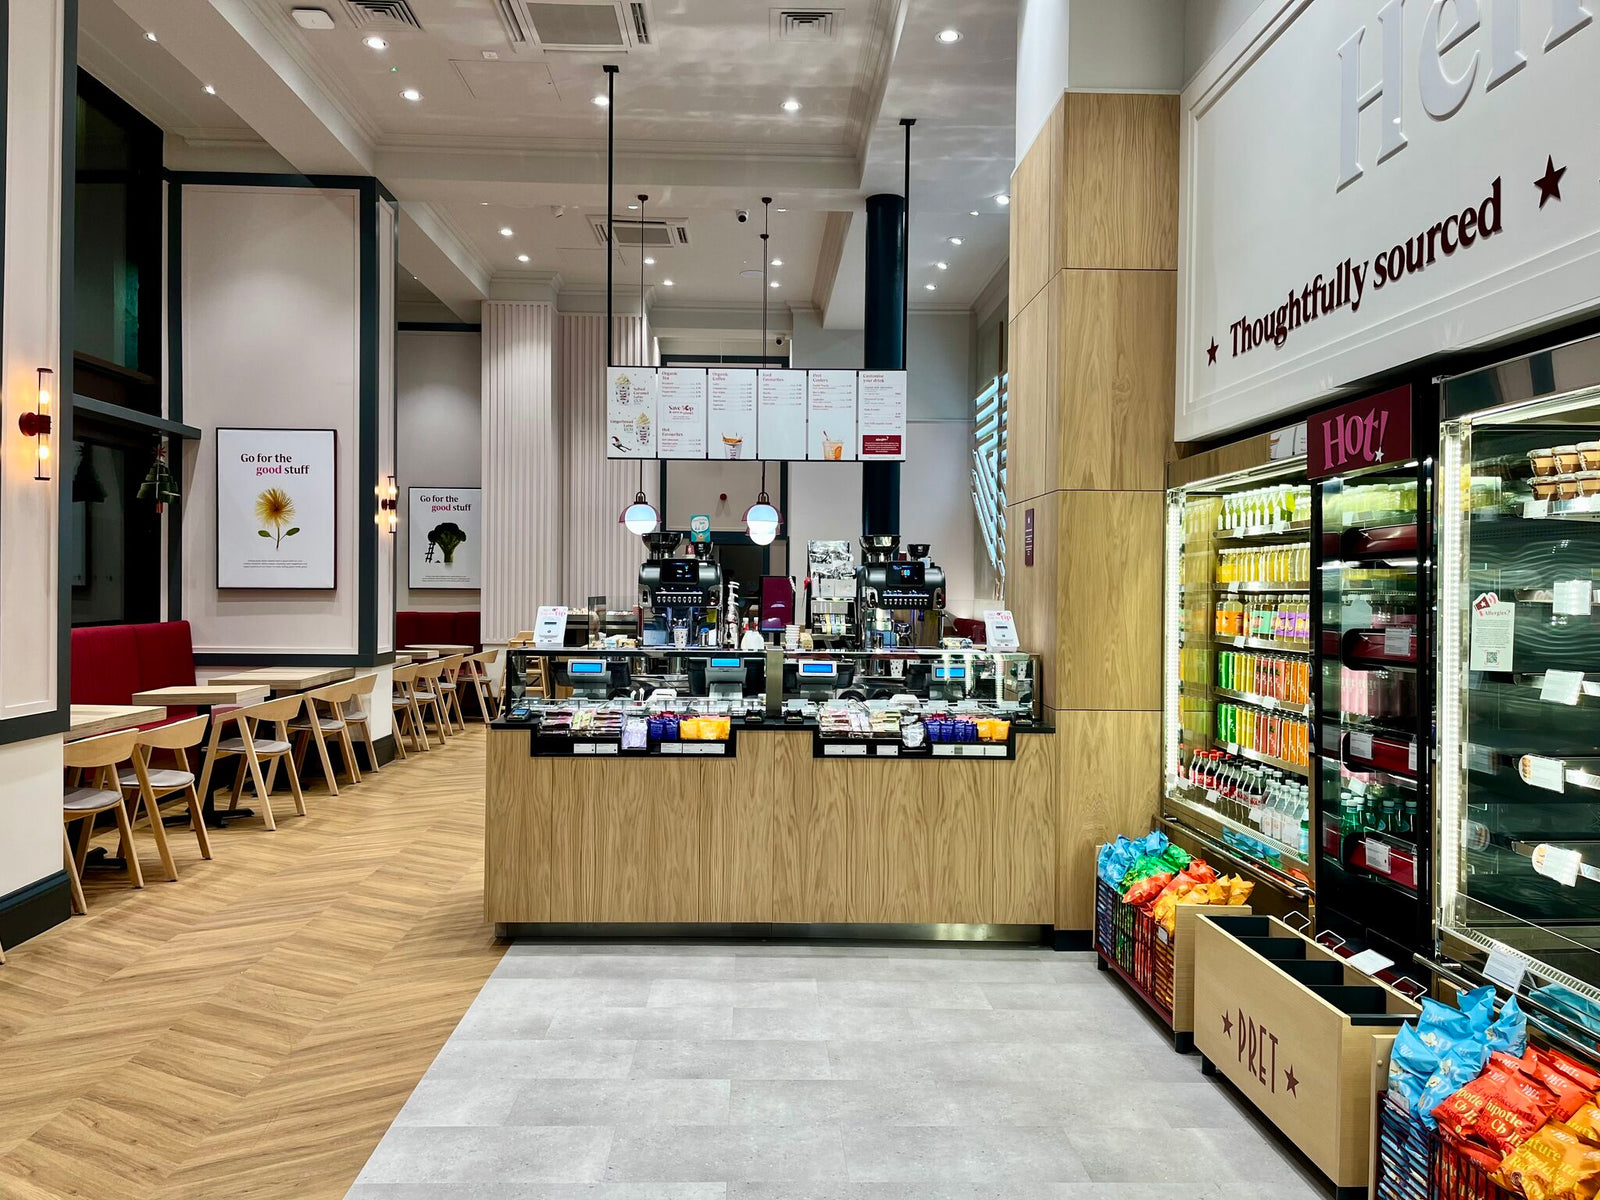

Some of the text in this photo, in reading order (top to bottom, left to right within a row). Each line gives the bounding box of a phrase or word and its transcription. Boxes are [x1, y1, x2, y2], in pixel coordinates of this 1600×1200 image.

[1230, 176, 1503, 358] Thoughtfully sourced
[1322, 408, 1389, 471] Hot!
[240, 453, 292, 463] Go for the
[255, 465, 310, 476] good stuff
[419, 494, 459, 503] Go for the
[431, 504, 451, 512] good
[1238, 1008, 1279, 1094] PRET
